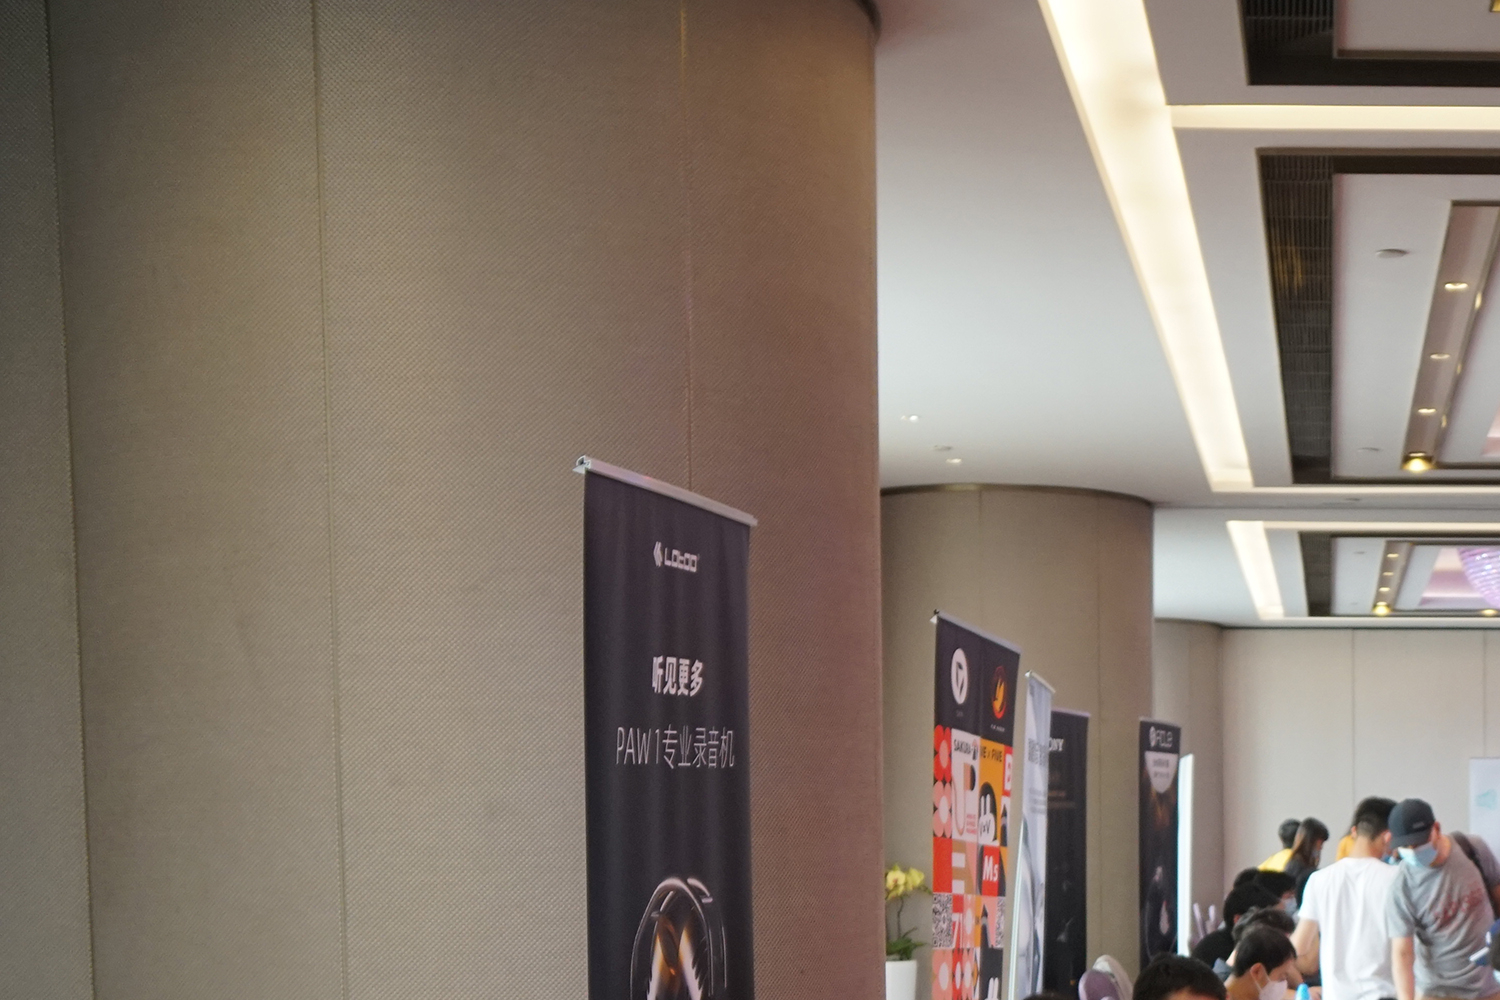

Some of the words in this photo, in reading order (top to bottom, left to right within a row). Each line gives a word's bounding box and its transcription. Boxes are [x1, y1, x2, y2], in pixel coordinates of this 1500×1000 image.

[651, 655, 703, 697] 听见更多
[1049, 737, 1064, 751] ONY
